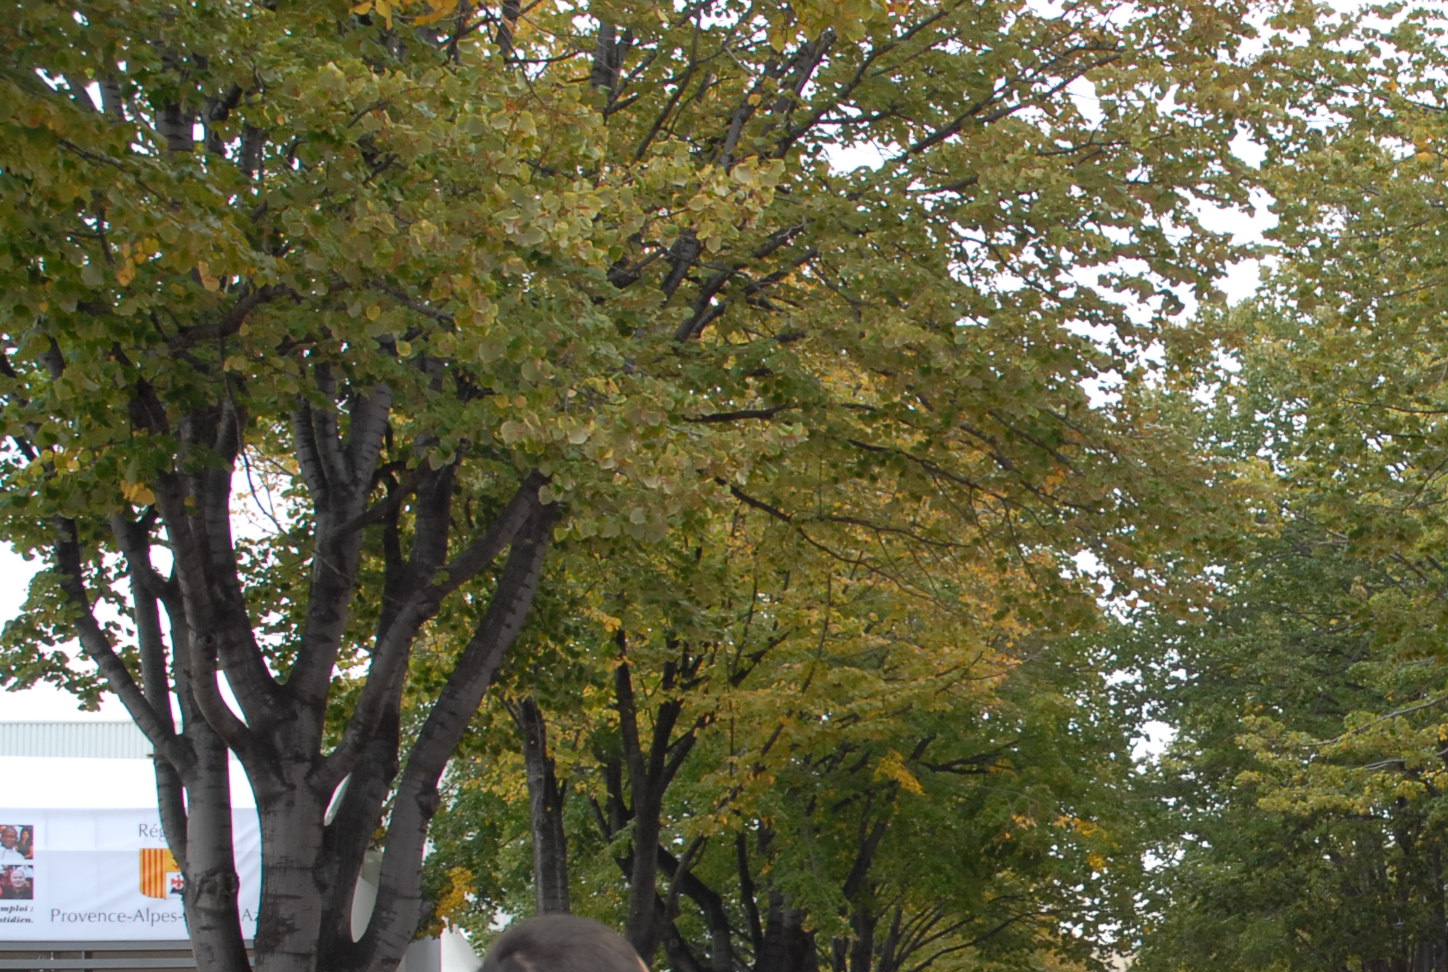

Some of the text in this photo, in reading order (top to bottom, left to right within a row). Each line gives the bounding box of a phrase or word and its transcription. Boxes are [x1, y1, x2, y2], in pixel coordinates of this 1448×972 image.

[139, 823, 166, 845] Rég
[0, 904, 28, 914] mploi
[0, 916, 34, 924] otidien.
[50, 908, 183, 926] Provence-Alpes-
